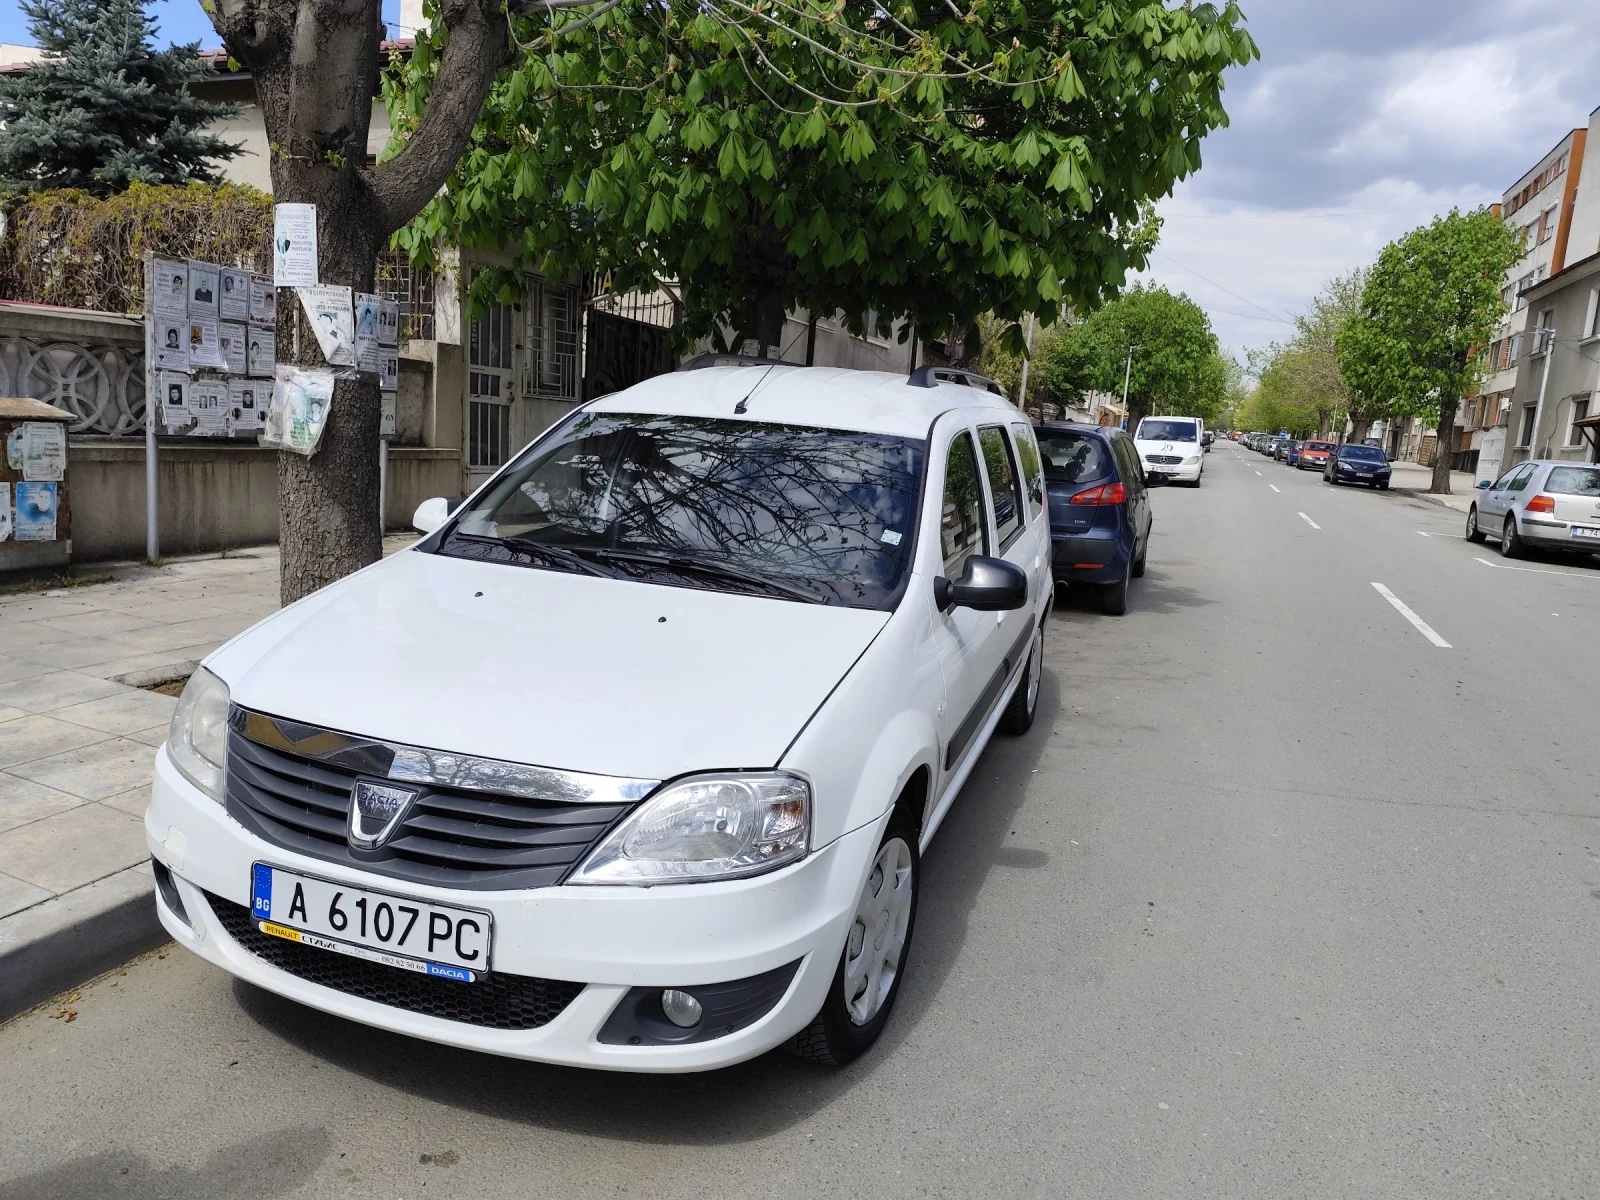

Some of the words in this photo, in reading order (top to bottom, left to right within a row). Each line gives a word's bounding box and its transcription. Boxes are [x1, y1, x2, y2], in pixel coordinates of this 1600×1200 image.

[359, 791, 399, 808] DACIA
[255, 897, 270, 911] BG
[288, 881, 308, 923] A
[266, 925, 298, 940] RENAULT
[431, 966, 465, 979] DACIA
